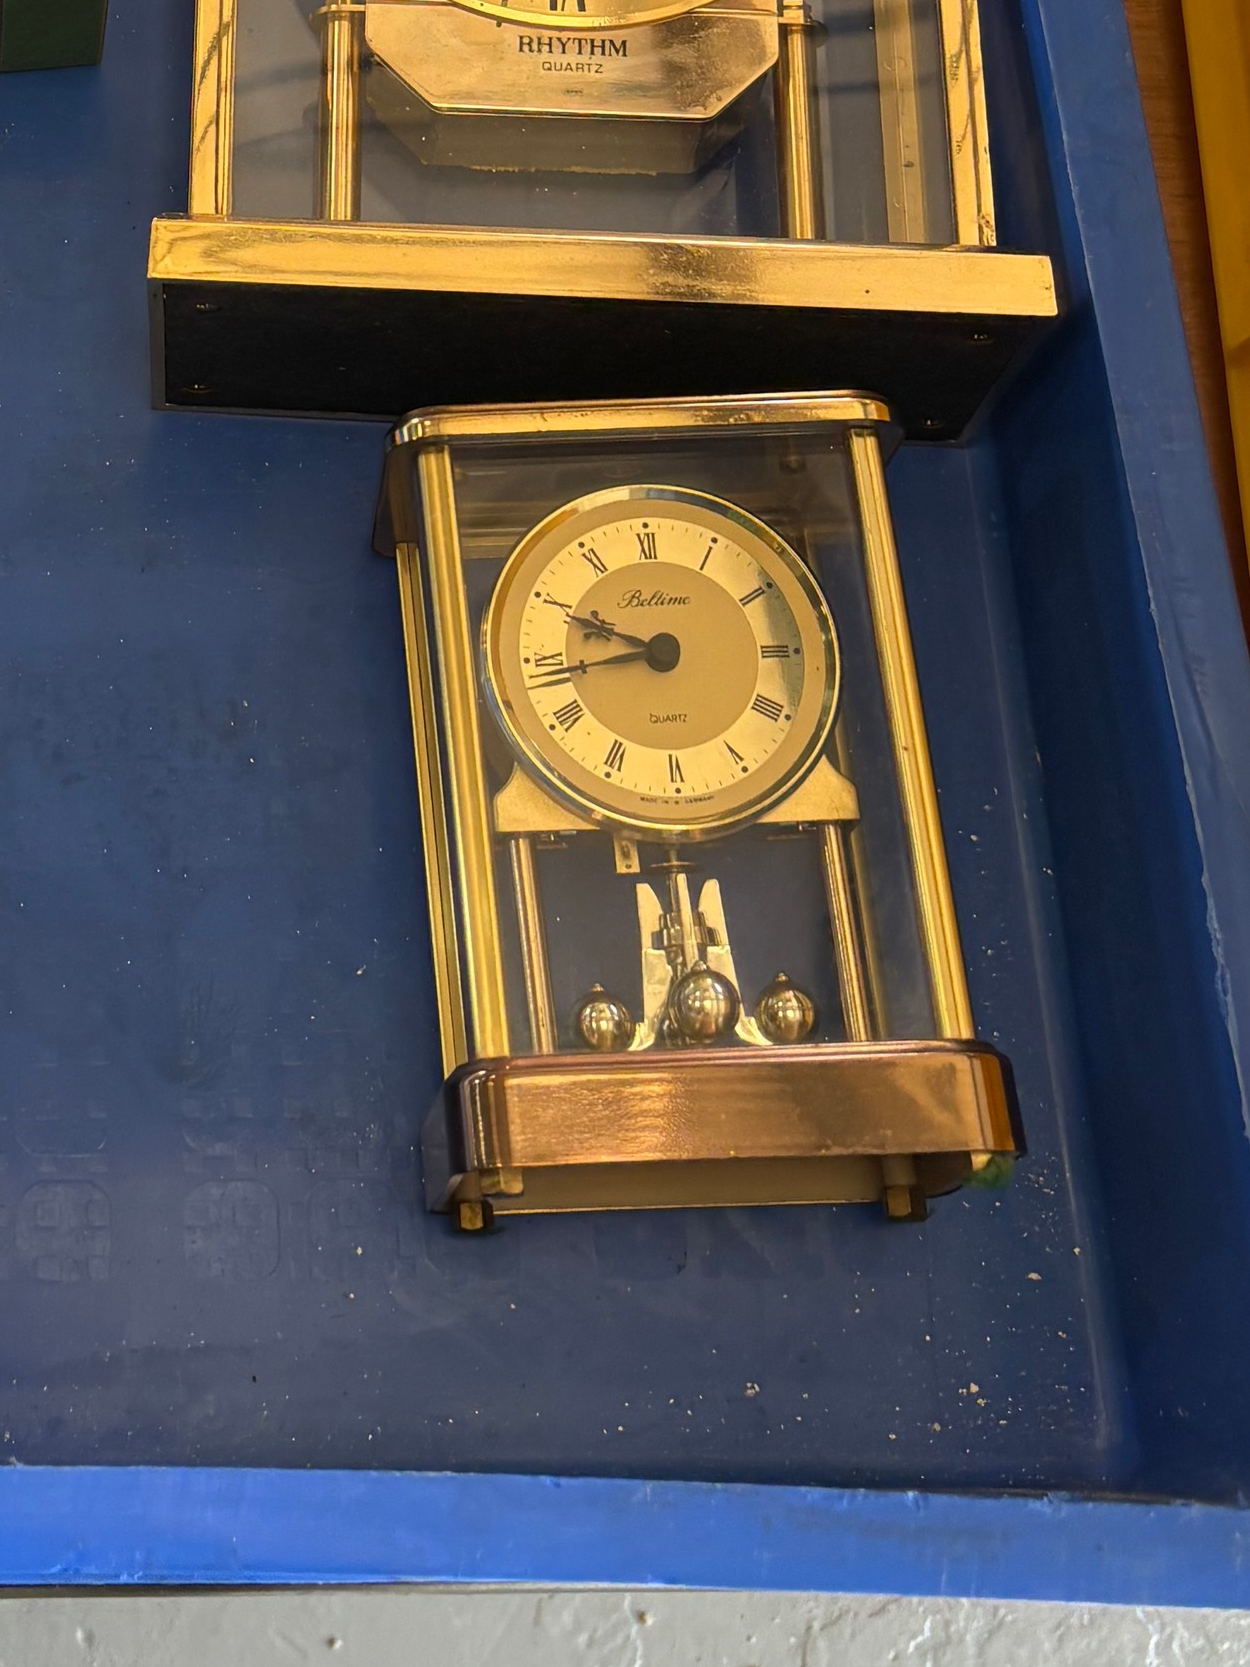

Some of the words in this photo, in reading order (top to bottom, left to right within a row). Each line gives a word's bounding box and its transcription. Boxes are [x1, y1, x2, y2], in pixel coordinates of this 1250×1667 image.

[518, 35, 628, 57] RHYTHM
[541, 60, 604, 74] QUARTZ
[636, 532, 658, 560] XII
[616, 589, 691, 610] Beltime
[738, 586, 765, 607] II
[760, 645, 790, 658] III
[649, 713, 688, 724] QUARTZ
